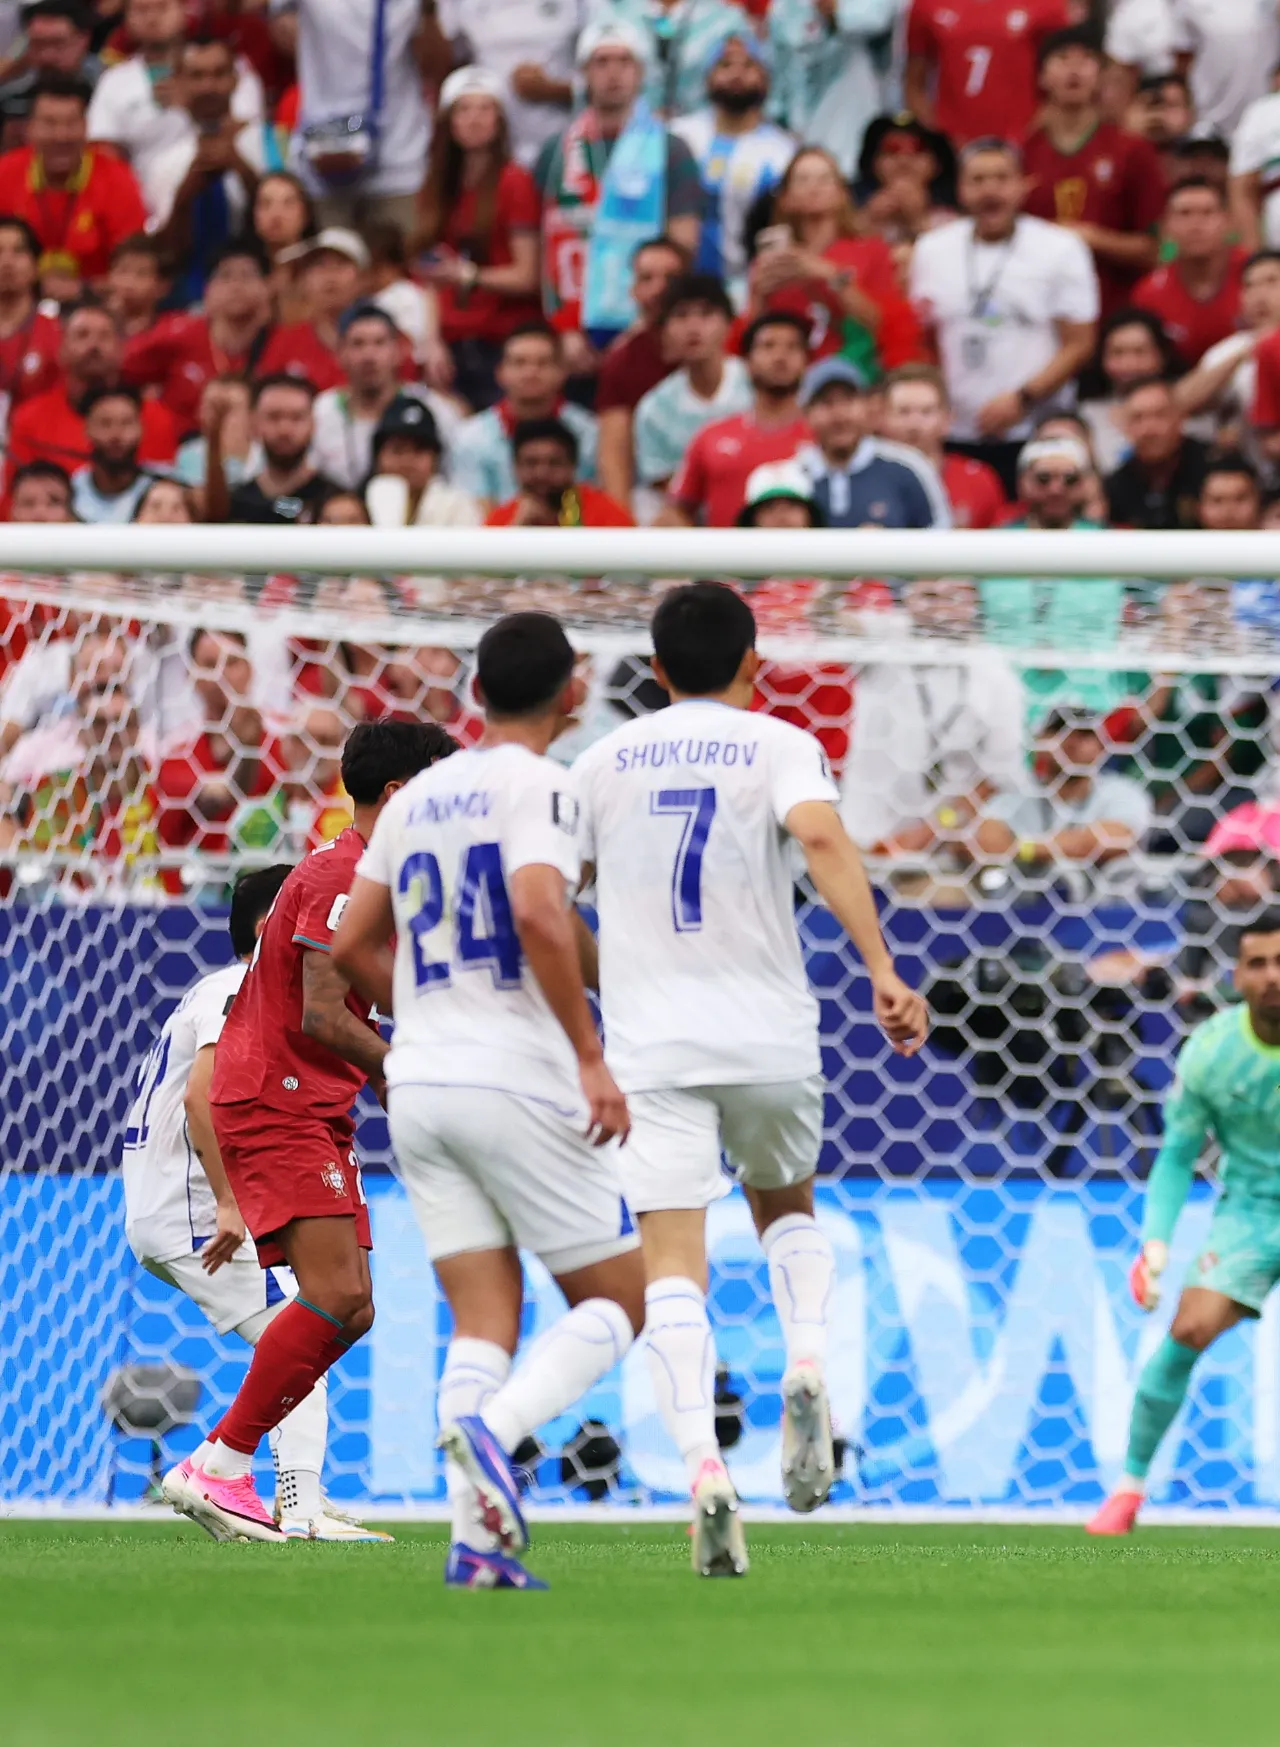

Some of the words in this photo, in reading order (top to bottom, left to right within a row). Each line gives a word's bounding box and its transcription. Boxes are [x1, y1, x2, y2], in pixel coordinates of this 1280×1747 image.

[614, 740, 758, 772] SHUKUROV
[397, 841, 522, 993] 24
[649, 785, 717, 934] 7
